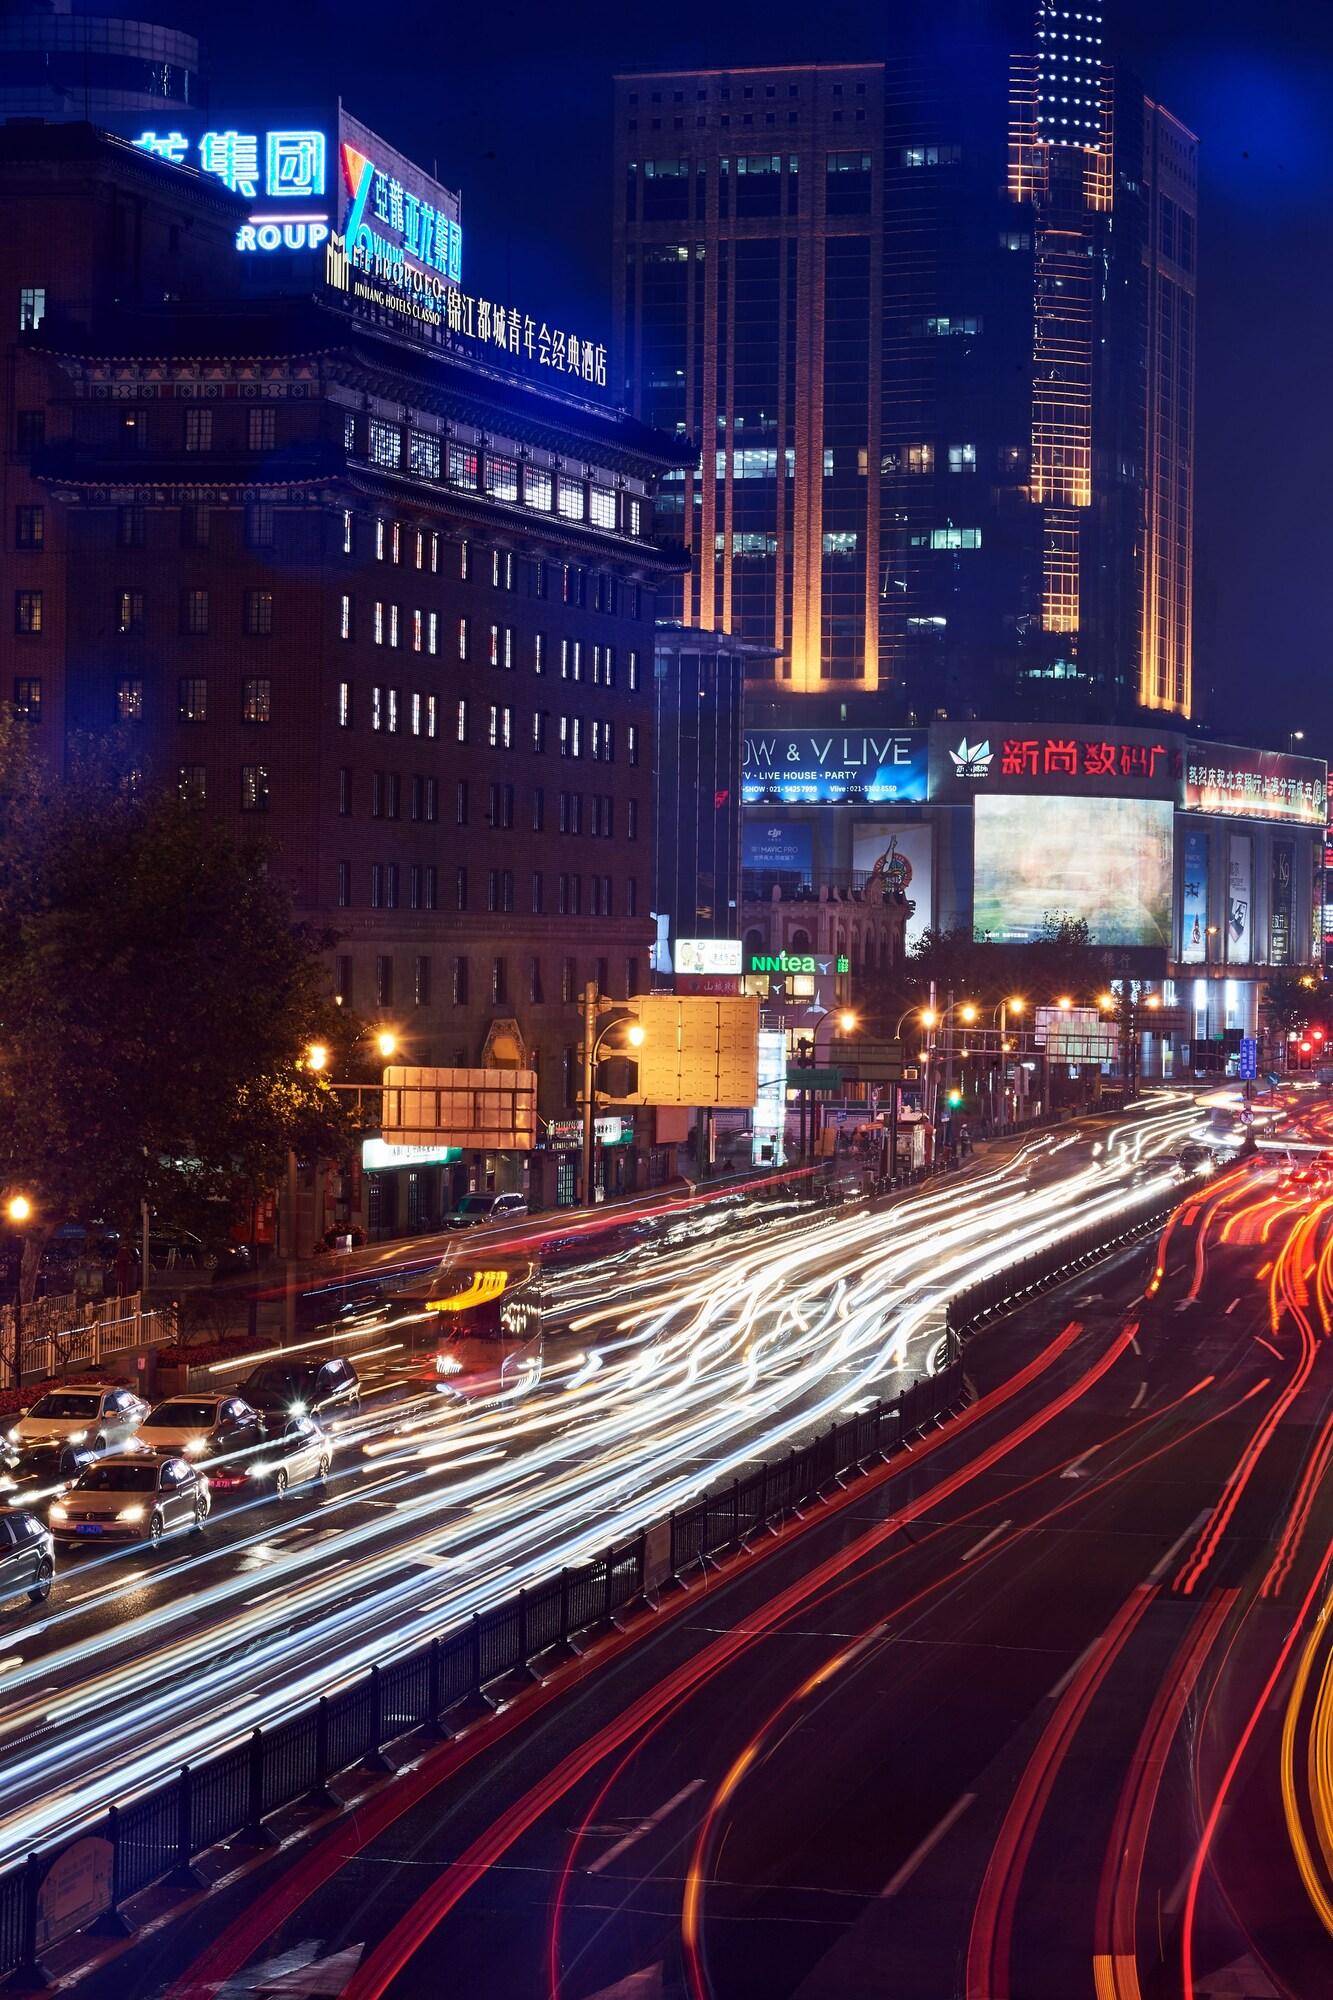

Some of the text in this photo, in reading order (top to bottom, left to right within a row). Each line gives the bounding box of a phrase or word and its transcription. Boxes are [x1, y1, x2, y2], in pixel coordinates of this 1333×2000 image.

[354, 281, 385, 305] JINJIANG
[385, 294, 412, 316] HOTELS
[447, 286, 608, 387] 锦江都城青年会经典酒店
[786, 743, 801, 762] &
[810, 738, 833, 765] V
[843, 737, 912, 765] LIVE
[1002, 739, 1183, 779] 新尚数码广
[759, 771, 781, 780] LIVE
[783, 771, 817, 780] HOUSE
[825, 771, 857, 780] PARTY
[751, 954, 816, 973] NNtea
